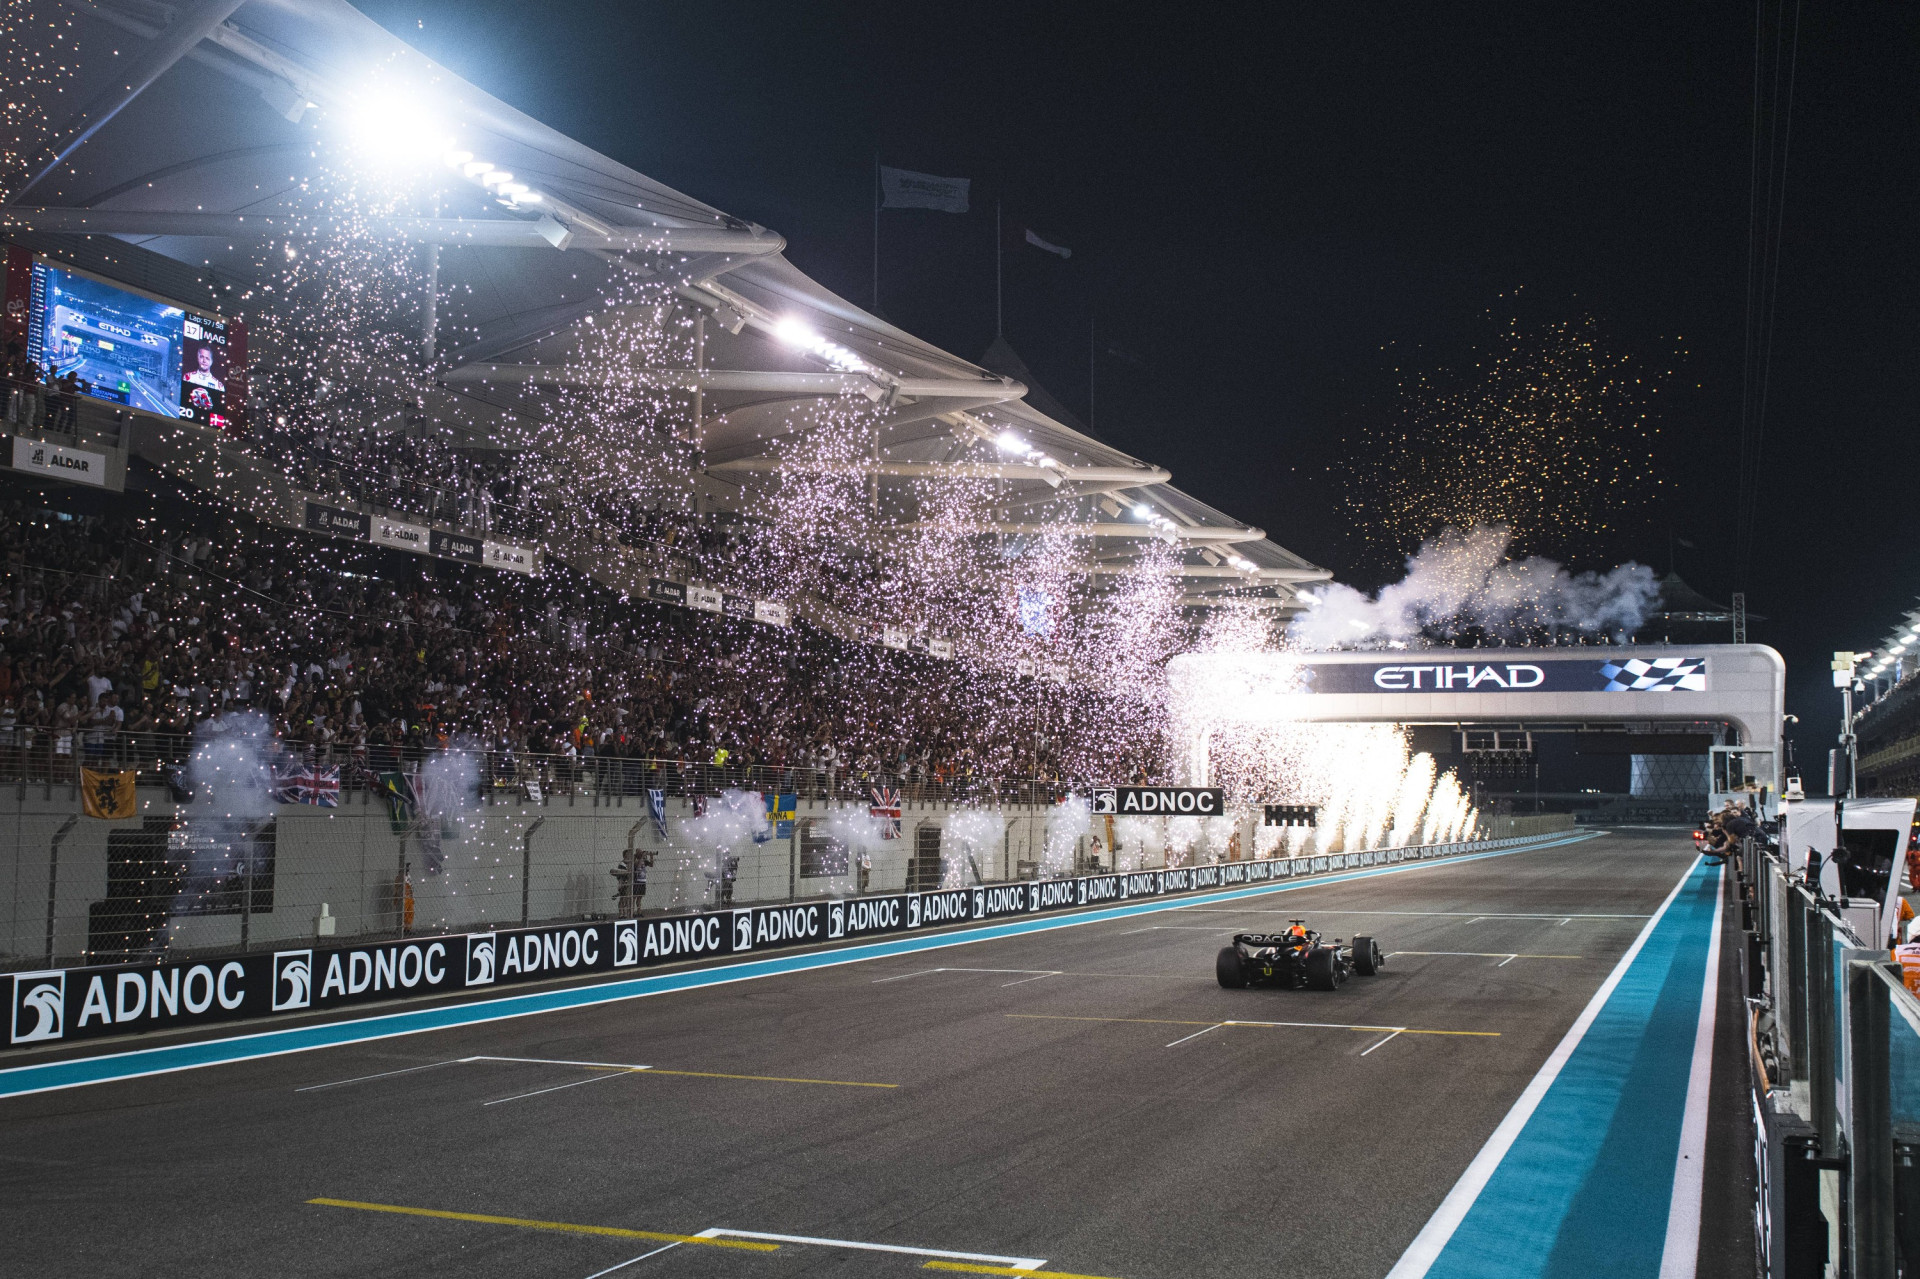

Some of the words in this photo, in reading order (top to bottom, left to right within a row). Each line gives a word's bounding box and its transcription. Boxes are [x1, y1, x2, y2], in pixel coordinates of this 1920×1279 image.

[98, 322, 131, 337] ETIHAD
[186, 326, 197, 335] 17
[204, 331, 226, 344] MAG
[179, 406, 194, 418] 20
[51, 454, 89, 472] ALDAR
[332, 516, 360, 530] ALDAR
[451, 542, 474, 554] ALDAR
[1374, 664, 1545, 689] ETIHAD
[1124, 792, 1214, 812] ADNOC
[1129, 874, 1154, 895] ADNOC
[1165, 870, 1188, 890] ADNOC
[1197, 867, 1218, 886] ADNOC
[1225, 865, 1244, 882] ADNOC
[987, 886, 1024, 911] ADNOC
[1041, 881, 1074, 906] ADNOC
[1088, 877, 1116, 900] ADNOC
[848, 900, 899, 931] ADNOC
[923, 892, 967, 922] ADNOC
[756, 906, 818, 943] ADNOC
[644, 918, 720, 958] ADNOC
[502, 928, 599, 974] ADNOC
[320, 942, 446, 998] ADNOC
[78, 962, 245, 1027] ADNOC
